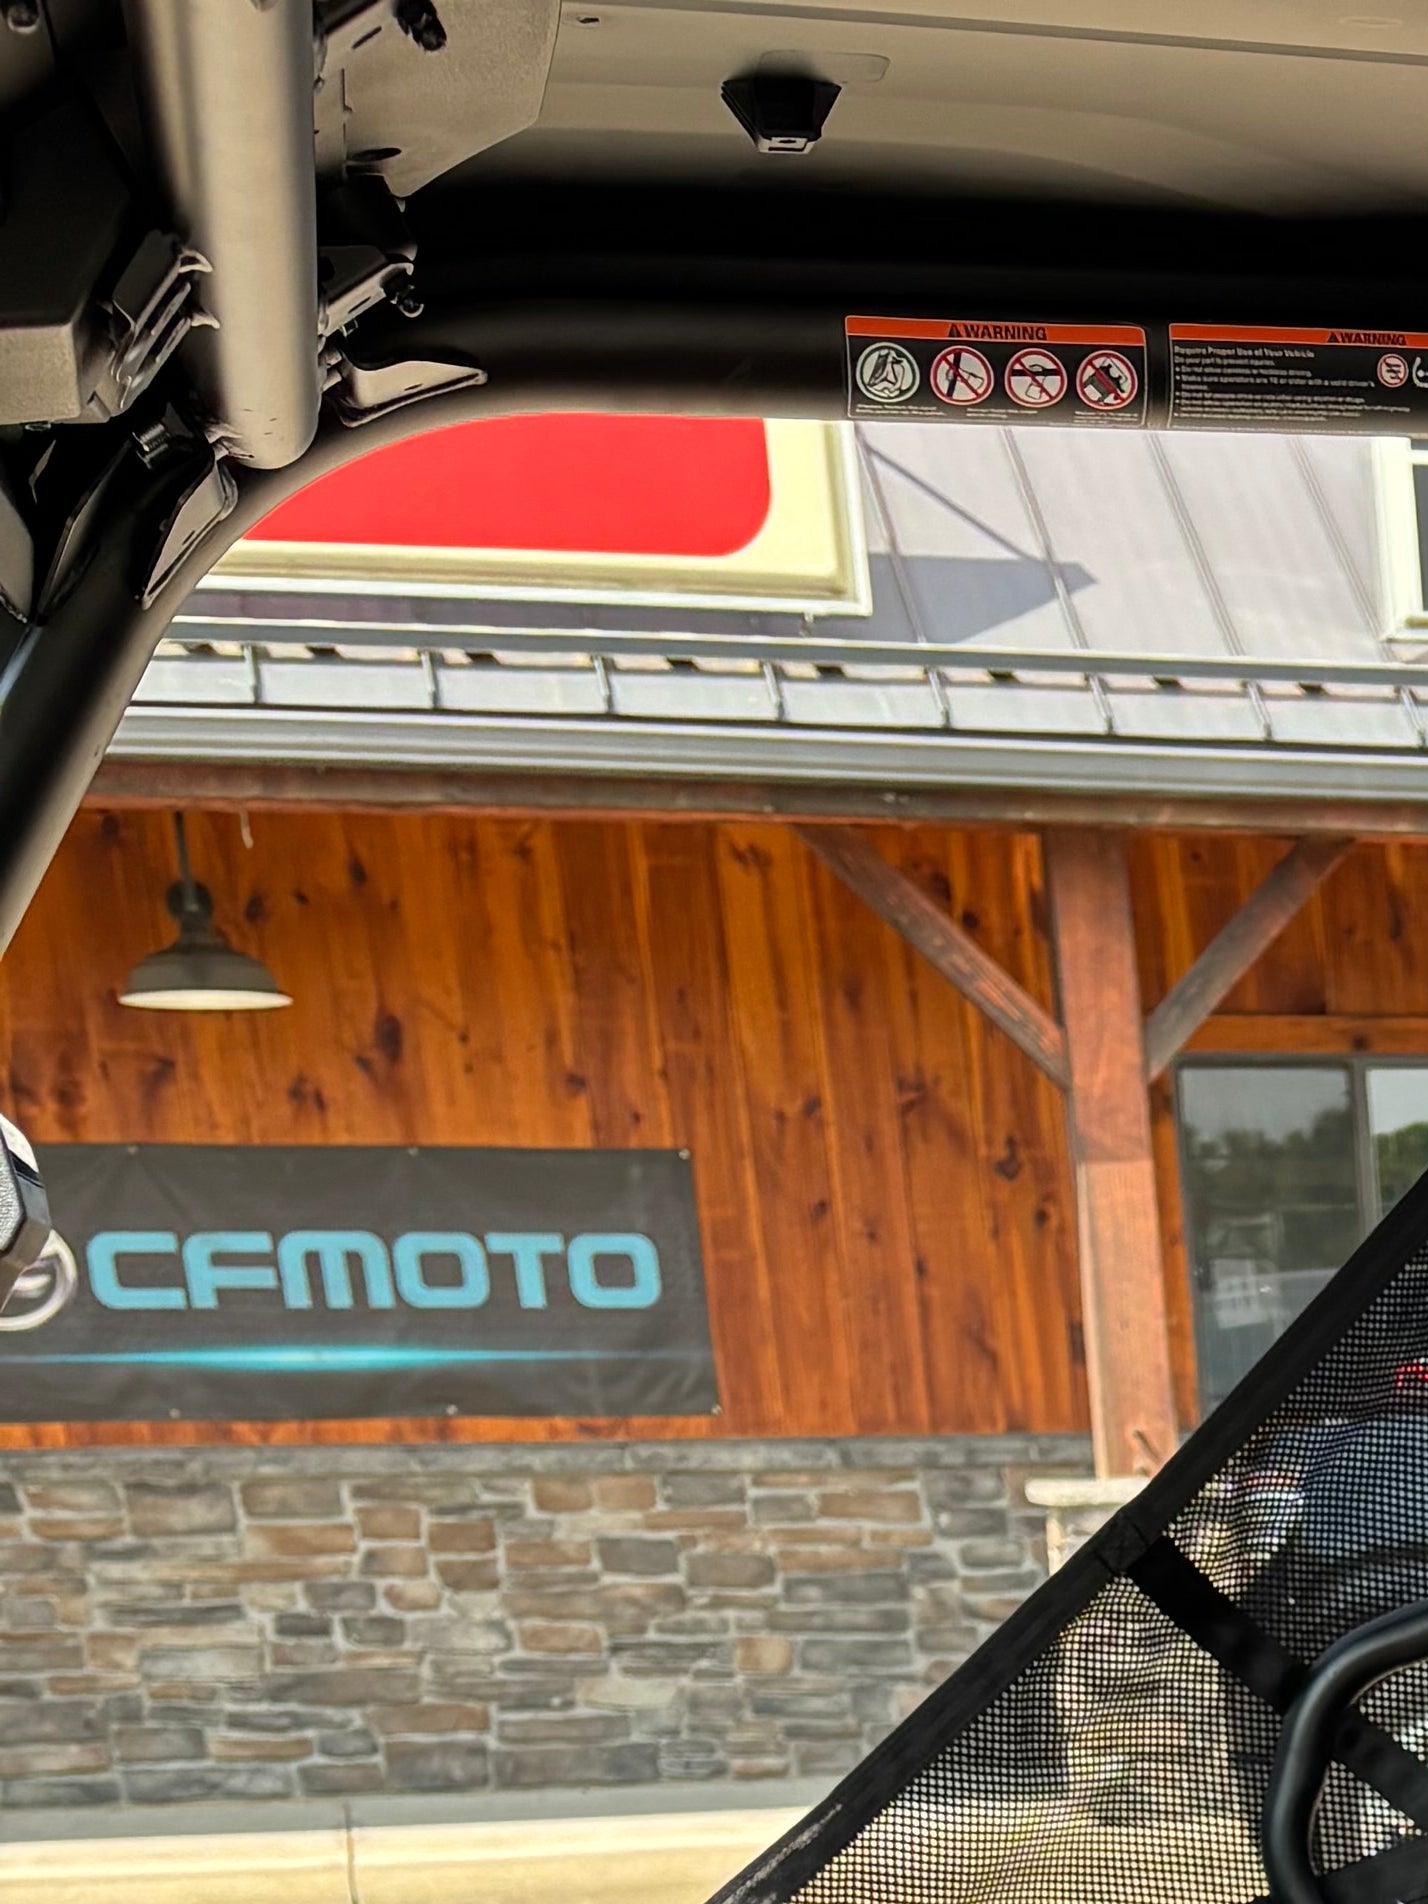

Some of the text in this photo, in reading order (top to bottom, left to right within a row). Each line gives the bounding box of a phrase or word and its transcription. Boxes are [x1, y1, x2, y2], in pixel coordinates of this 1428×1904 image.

[963, 324, 1048, 341] WARNING
[1338, 332, 1407, 346] WARNING
[87, 1231, 662, 1310] CFMOTO
